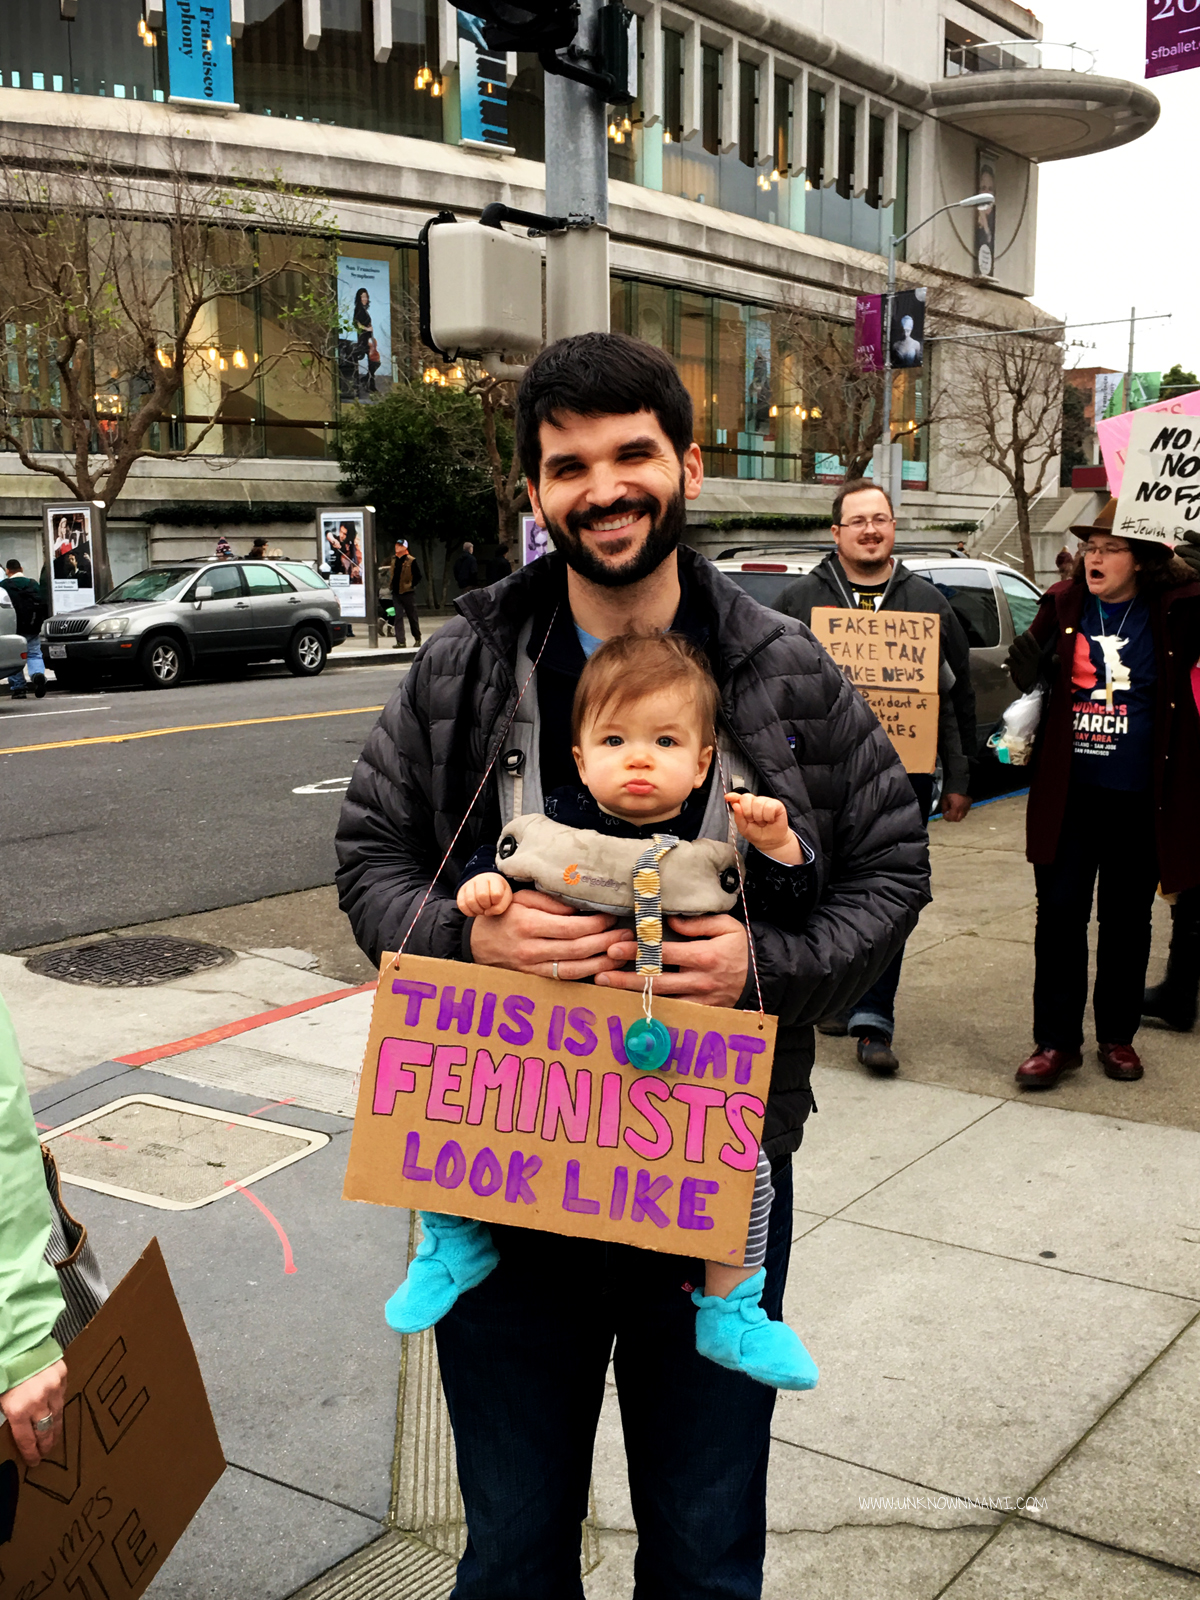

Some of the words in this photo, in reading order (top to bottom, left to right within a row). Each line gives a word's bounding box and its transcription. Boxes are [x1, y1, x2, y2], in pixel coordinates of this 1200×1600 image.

[177, 0, 193, 59] phony
[200, 6, 217, 97] Francisco
[1151, 40, 1200, 60] sfballet.
[1149, 427, 1192, 452] NO
[1160, 452, 1200, 478] NO
[1135, 481, 1172, 502] NO
[828, 617, 879, 636] FAKE
[884, 617, 935, 640] HAIR
[830, 642, 878, 660] FAKE
[884, 641, 926, 665] TAN
[882, 667, 925, 682] NEWS
[1091, 734, 1112, 743] AREA
[391, 978, 535, 1046] THIS
[547, 1005, 598, 1056] IS
[372, 1037, 766, 1172] FEMINISTS
[402, 1131, 542, 1205] LOOK
[562, 1158, 720, 1230] LIKE
[24, 1335, 150, 1505] VE
[63, 1508, 158, 1600] TE
